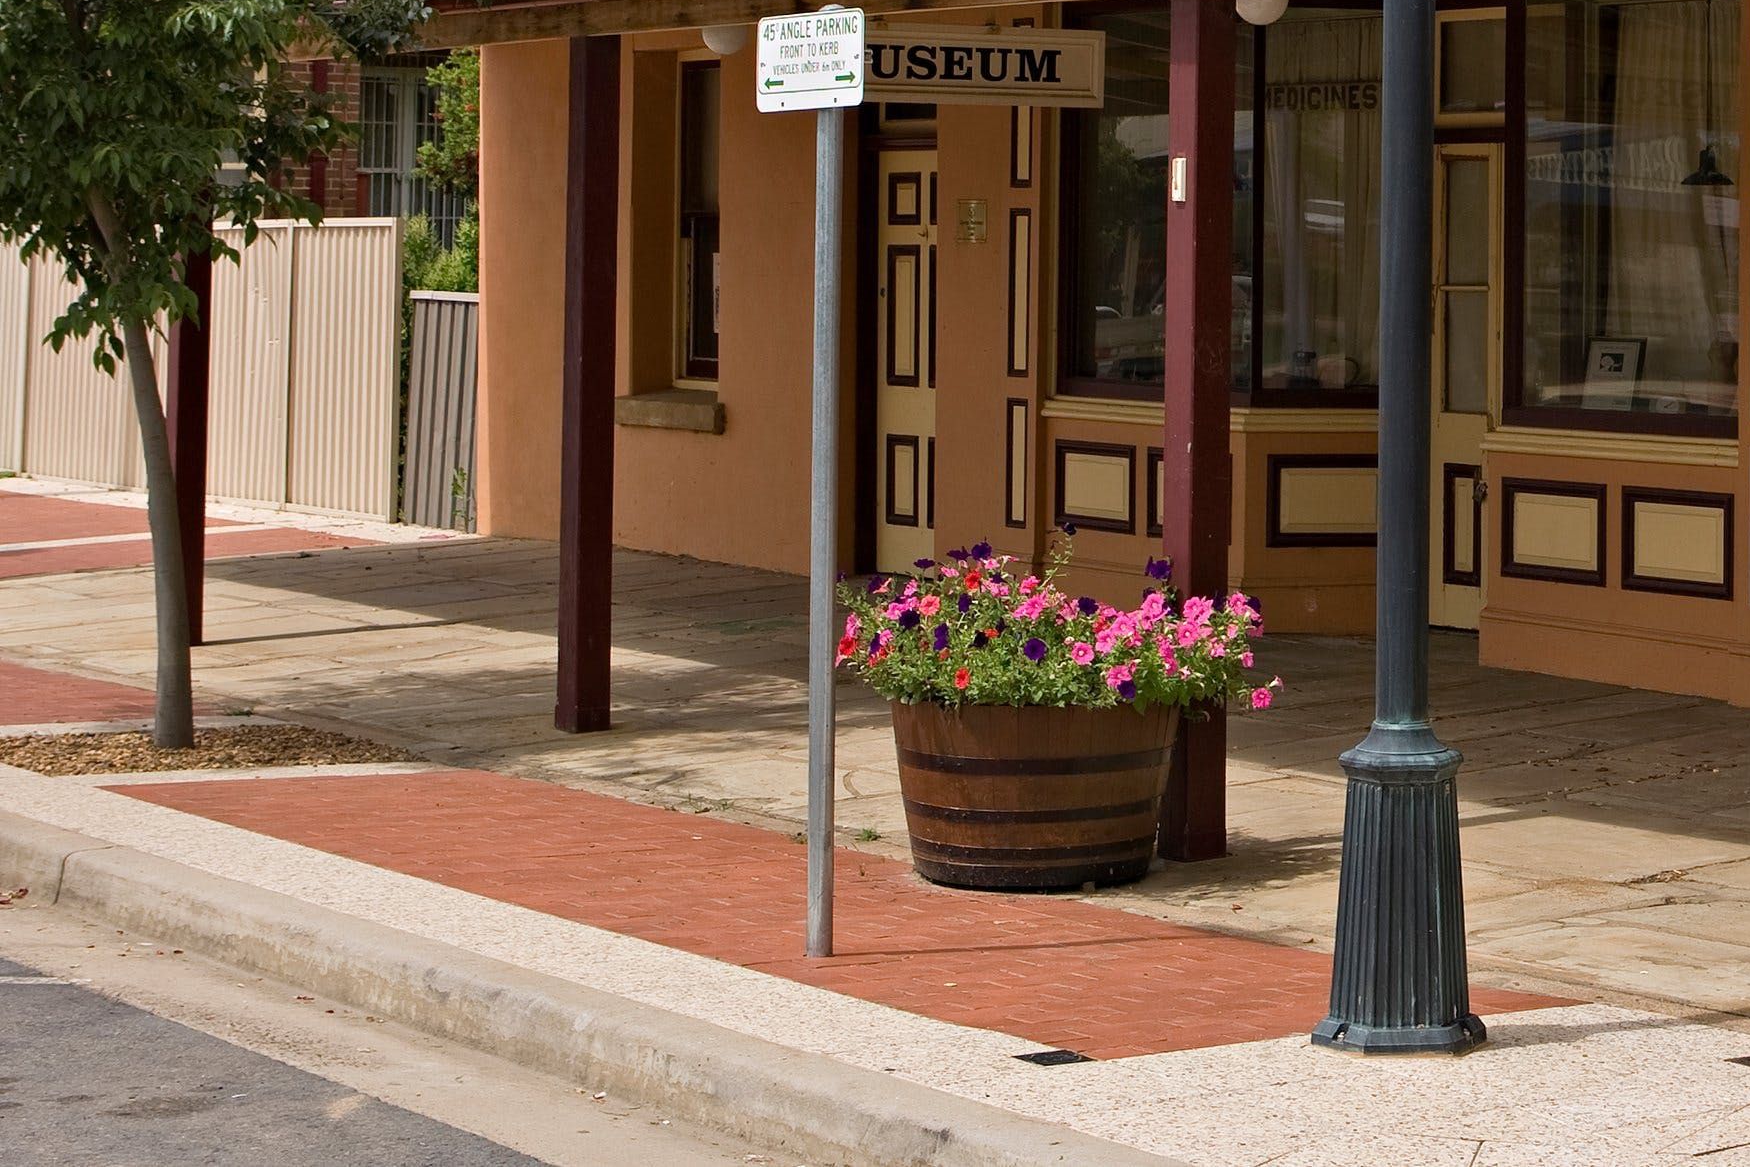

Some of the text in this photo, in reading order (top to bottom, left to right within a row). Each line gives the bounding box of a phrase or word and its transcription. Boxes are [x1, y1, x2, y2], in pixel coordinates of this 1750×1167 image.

[780, 20, 811, 40] ANGLE
[816, 15, 858, 37] PARKING
[780, 41, 839, 59] FRONT TO KERB
[773, 64, 798, 75] VEHICLES
[801, 61, 820, 74] UNDER
[831, 60, 846, 72] ONLY
[866, 43, 1062, 83] USEUM
